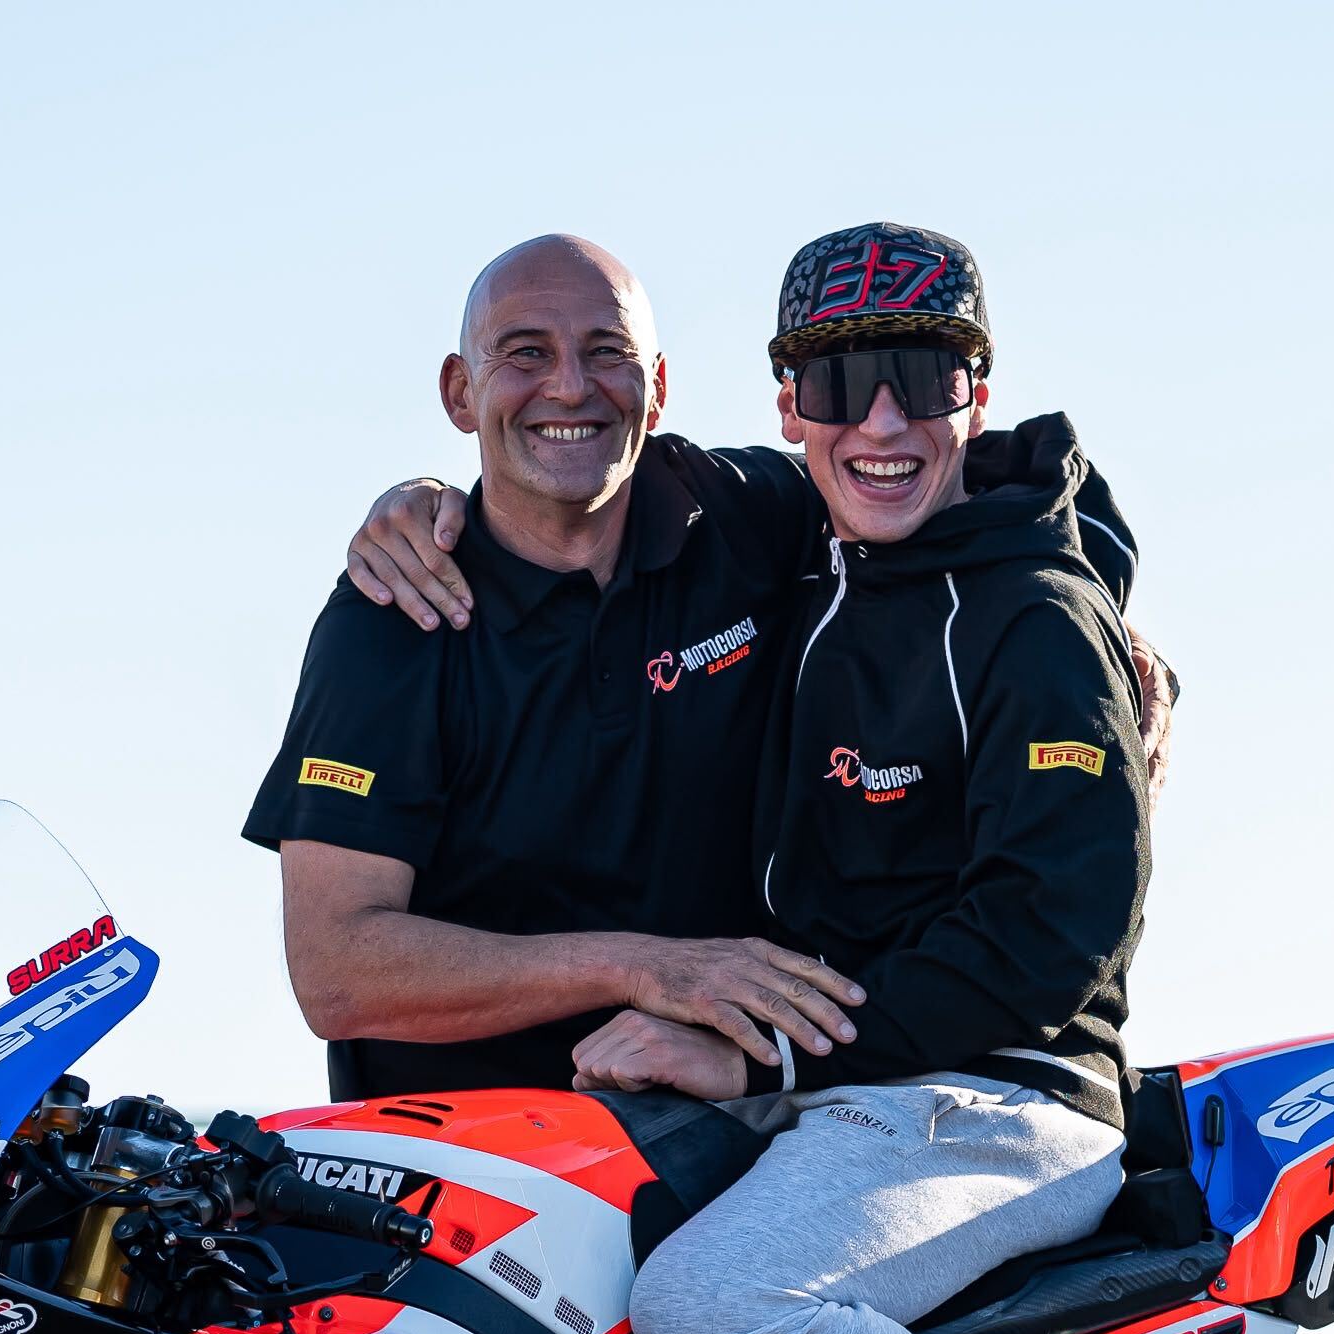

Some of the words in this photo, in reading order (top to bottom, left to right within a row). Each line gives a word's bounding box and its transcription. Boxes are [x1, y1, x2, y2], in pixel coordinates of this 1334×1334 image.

[681, 616, 758, 671] MOTOCORSA
[707, 645, 750, 675] RACING
[1038, 747, 1097, 771] PIRELLI
[307, 761, 365, 790] PIRELLI
[865, 788, 906, 803] ACING
[7, 914, 117, 996] SURRA
[826, 1106, 898, 1137] MCKENZIE
[296, 1155, 404, 1198] UCATI
